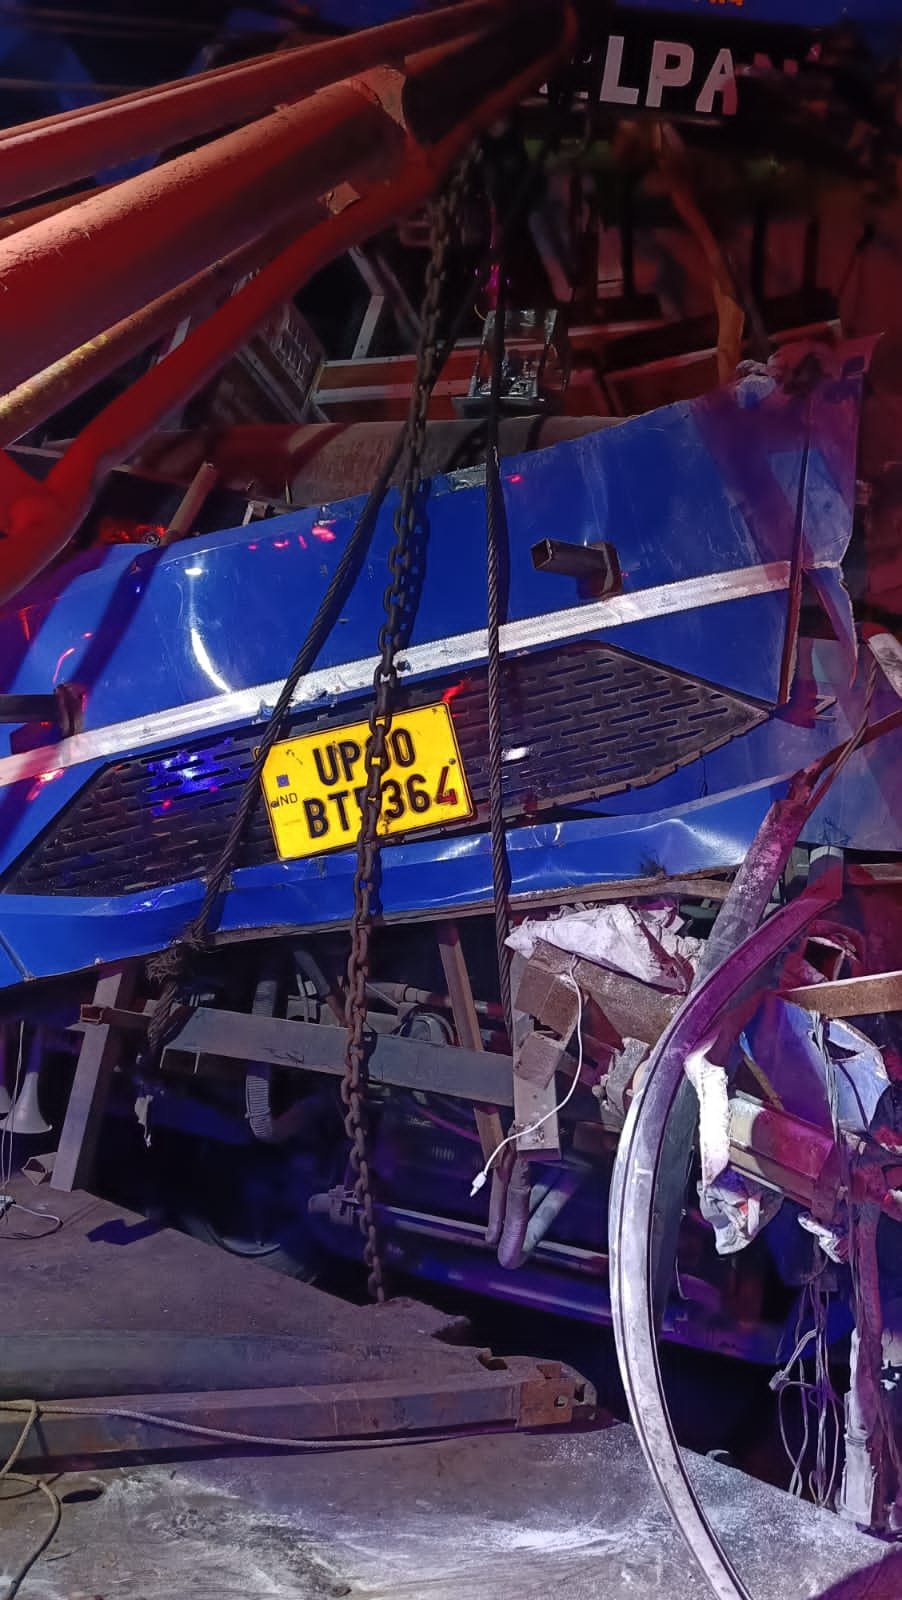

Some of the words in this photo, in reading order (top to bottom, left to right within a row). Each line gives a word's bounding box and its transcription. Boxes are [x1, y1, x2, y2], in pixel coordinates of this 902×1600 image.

[312, 727, 416, 786] UP0
[276, 792, 298, 807] IND
[303, 765, 458, 839] BT364
